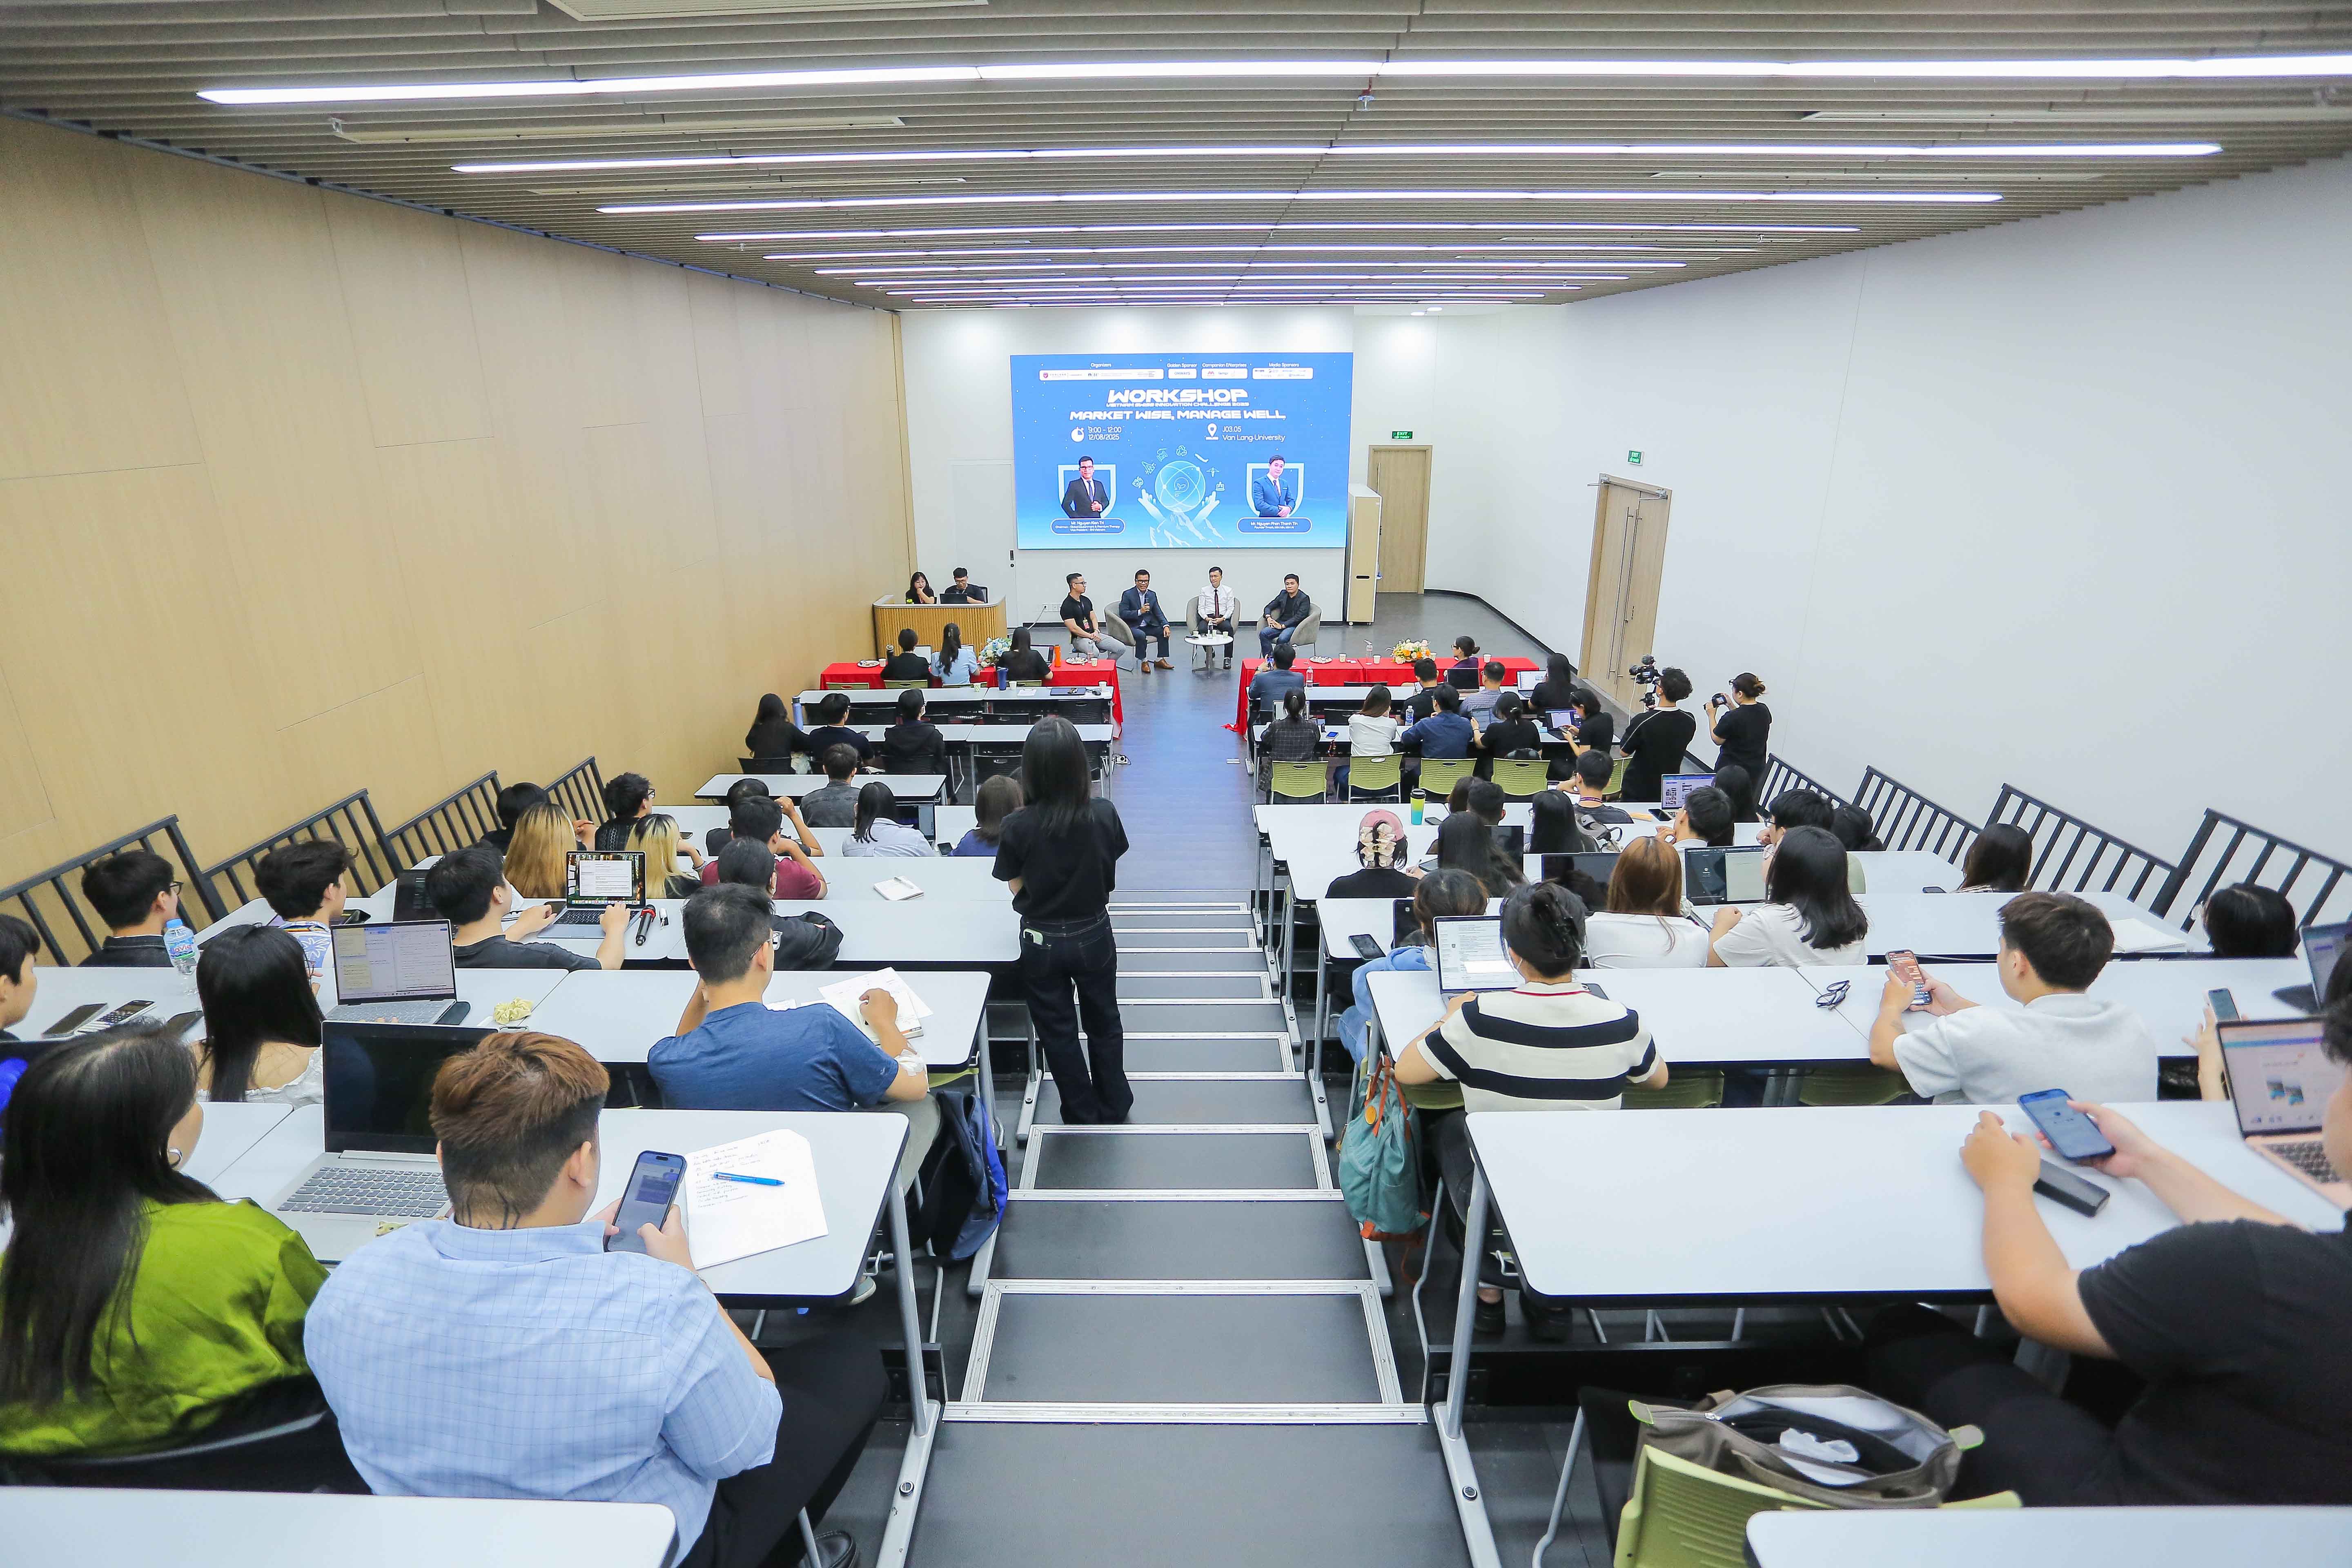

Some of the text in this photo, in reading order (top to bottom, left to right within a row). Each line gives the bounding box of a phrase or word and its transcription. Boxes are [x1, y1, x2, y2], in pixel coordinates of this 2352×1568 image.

[1108, 389, 1248, 403] WORKSHOP
[1069, 410, 1286, 420] MARKET WISE, MANAGE WELL
[1237, 434, 1253, 443] Lang
[1254, 434, 1286, 442] University
